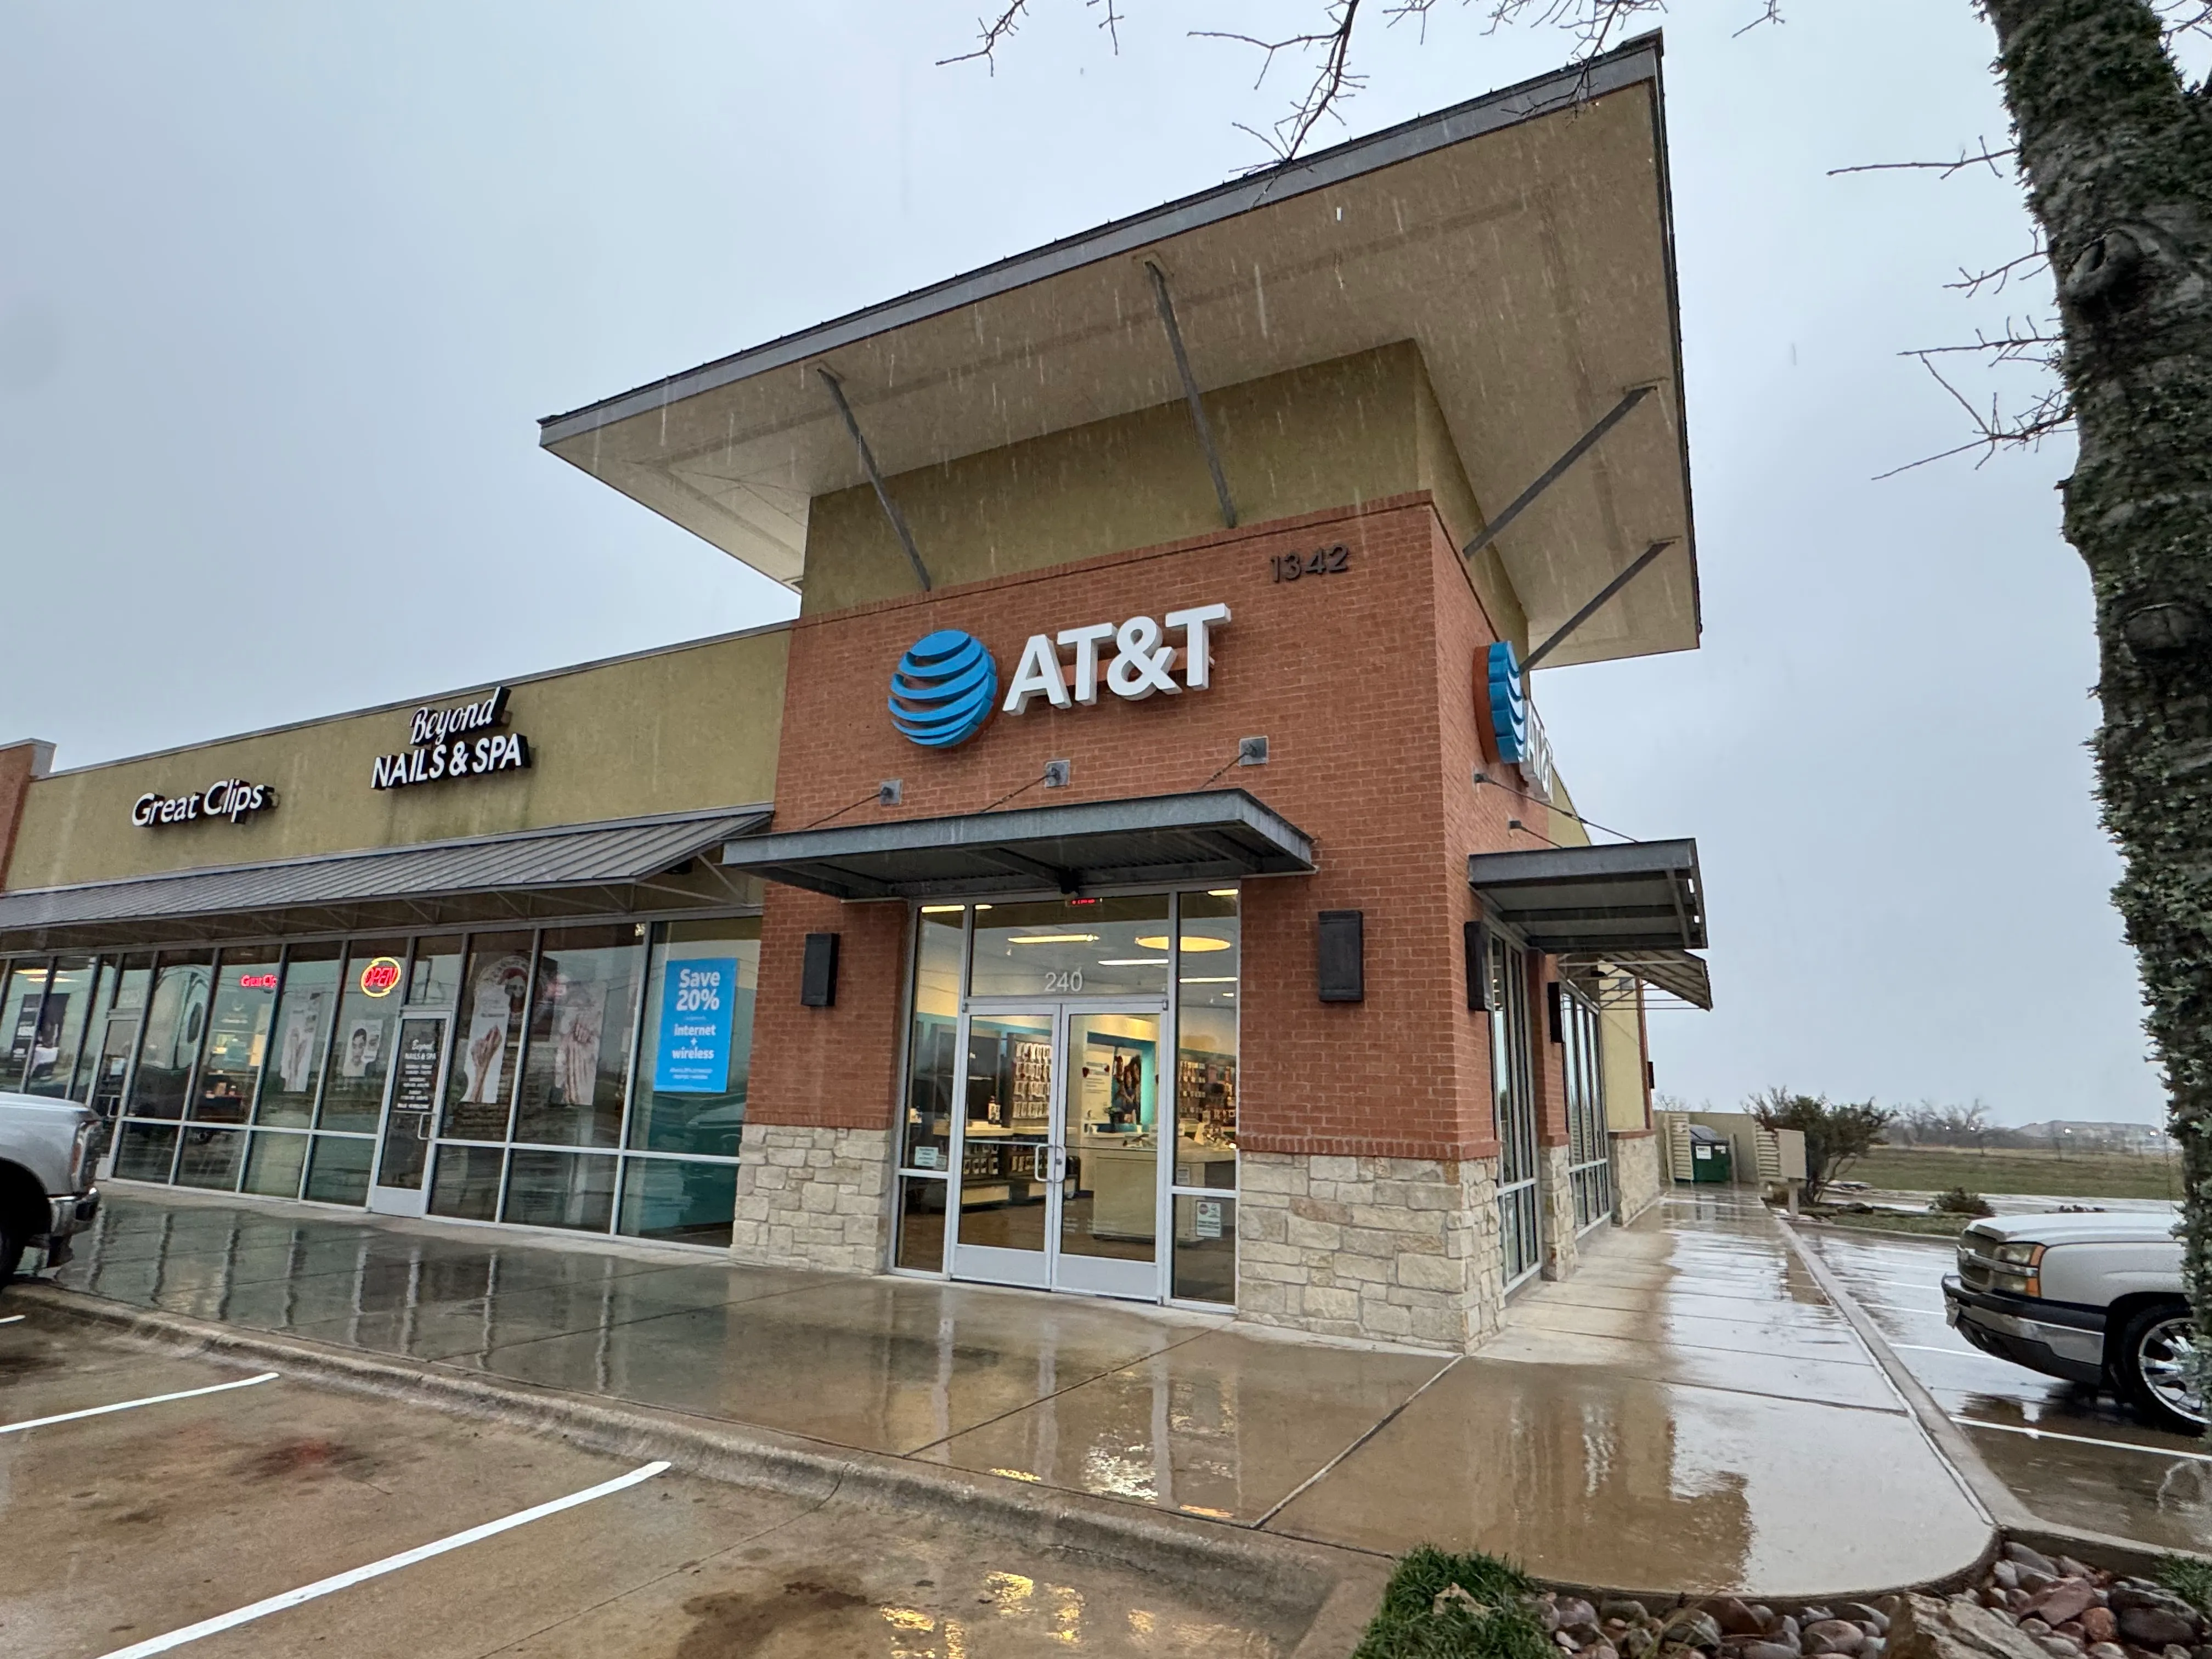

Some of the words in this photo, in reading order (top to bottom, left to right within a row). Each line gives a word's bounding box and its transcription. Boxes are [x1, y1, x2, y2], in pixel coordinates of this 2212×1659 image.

[1271, 543, 1350, 583] 1342
[1003, 603, 1231, 716] AT&T
[410, 686, 503, 745] Beyond
[370, 744, 447, 789] NAILS
[449, 741, 469, 777] &
[472, 733, 522, 774] SPA
[132, 793, 199, 826] Great
[204, 778, 264, 823] Clips
[364, 967, 398, 988] OPEN
[679, 969, 721, 988] Save
[1044, 970, 1084, 992] 240
[676, 989, 720, 1011] 20%
[674, 1024, 716, 1036] internet
[672, 1047, 715, 1060] wireless
